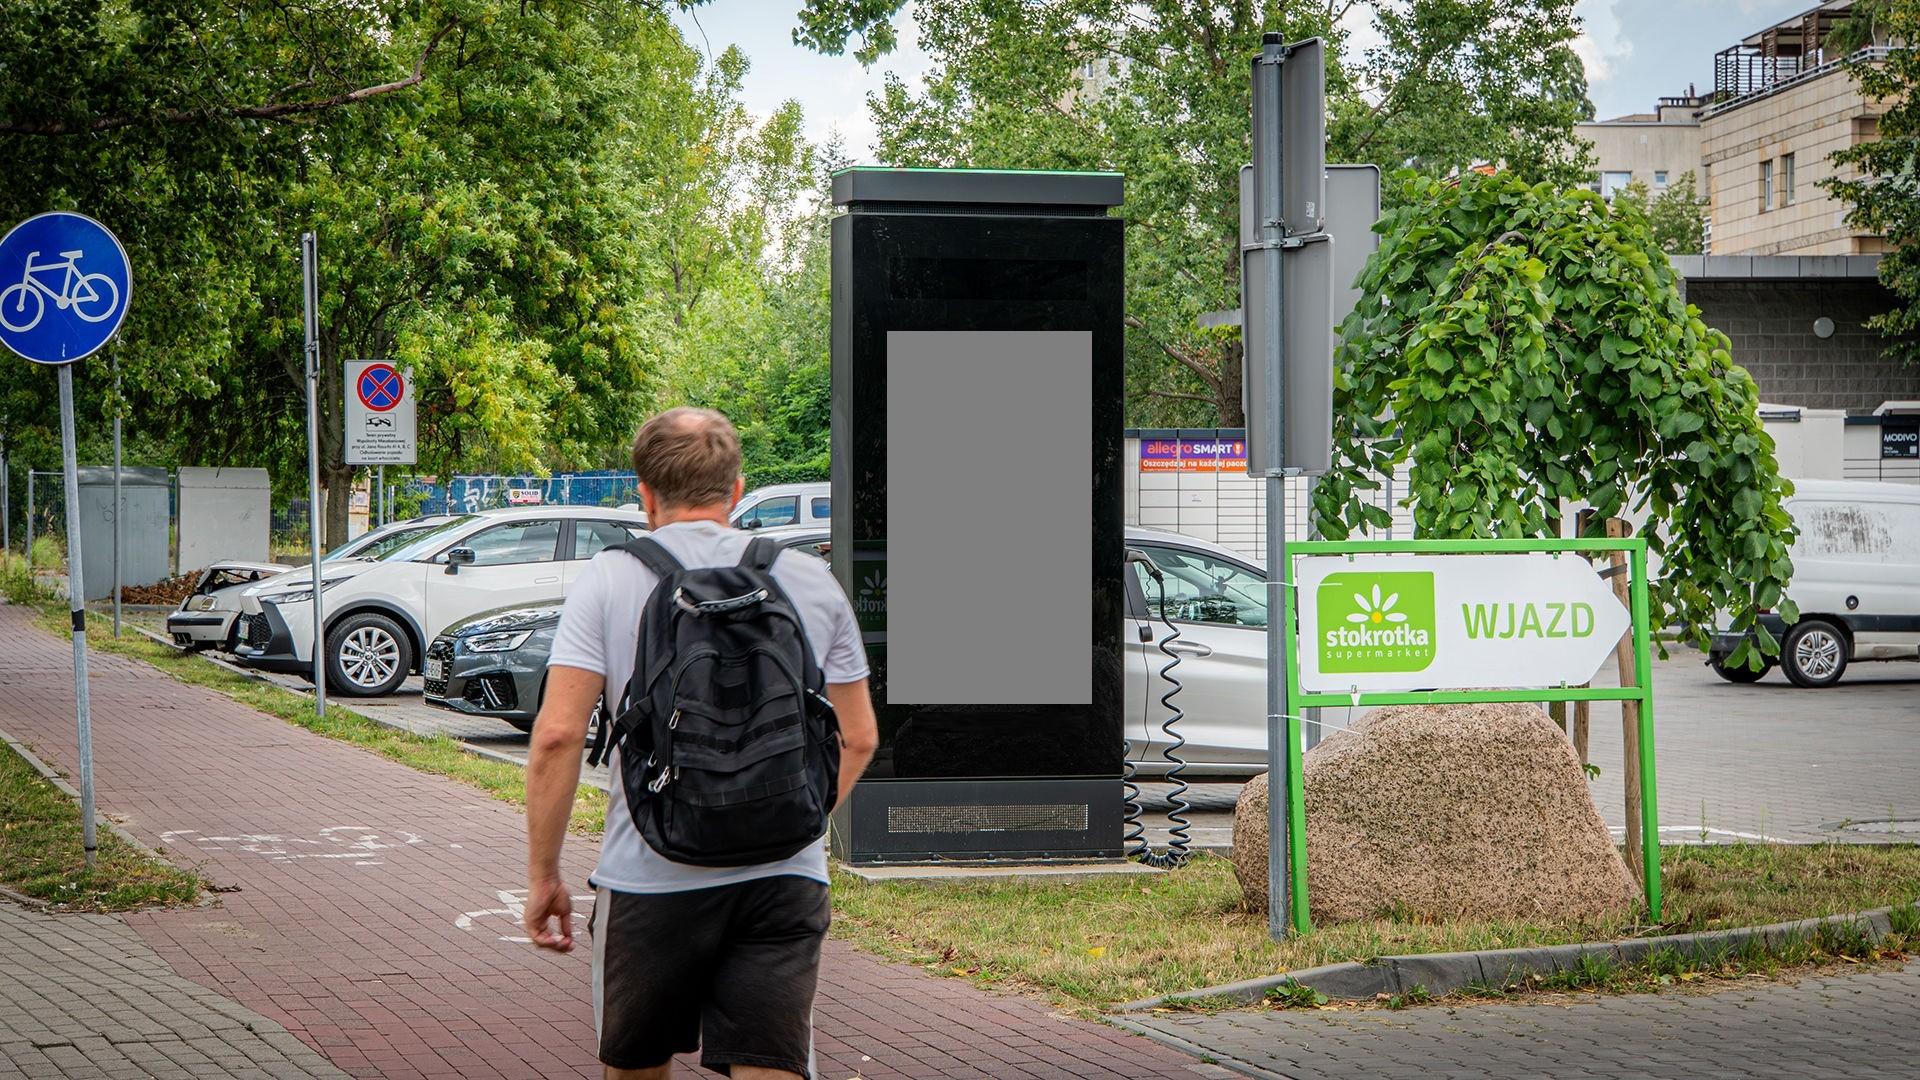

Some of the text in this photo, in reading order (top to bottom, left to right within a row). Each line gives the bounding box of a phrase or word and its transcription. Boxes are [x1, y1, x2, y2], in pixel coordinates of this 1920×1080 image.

[1883, 433, 1918, 442] MODIVO
[1147, 441, 1193, 457] allegro
[1462, 602, 1595, 639] WJAZD
[1326, 623, 1429, 648] stokrotka
[1326, 648, 1429, 660] supermarket
